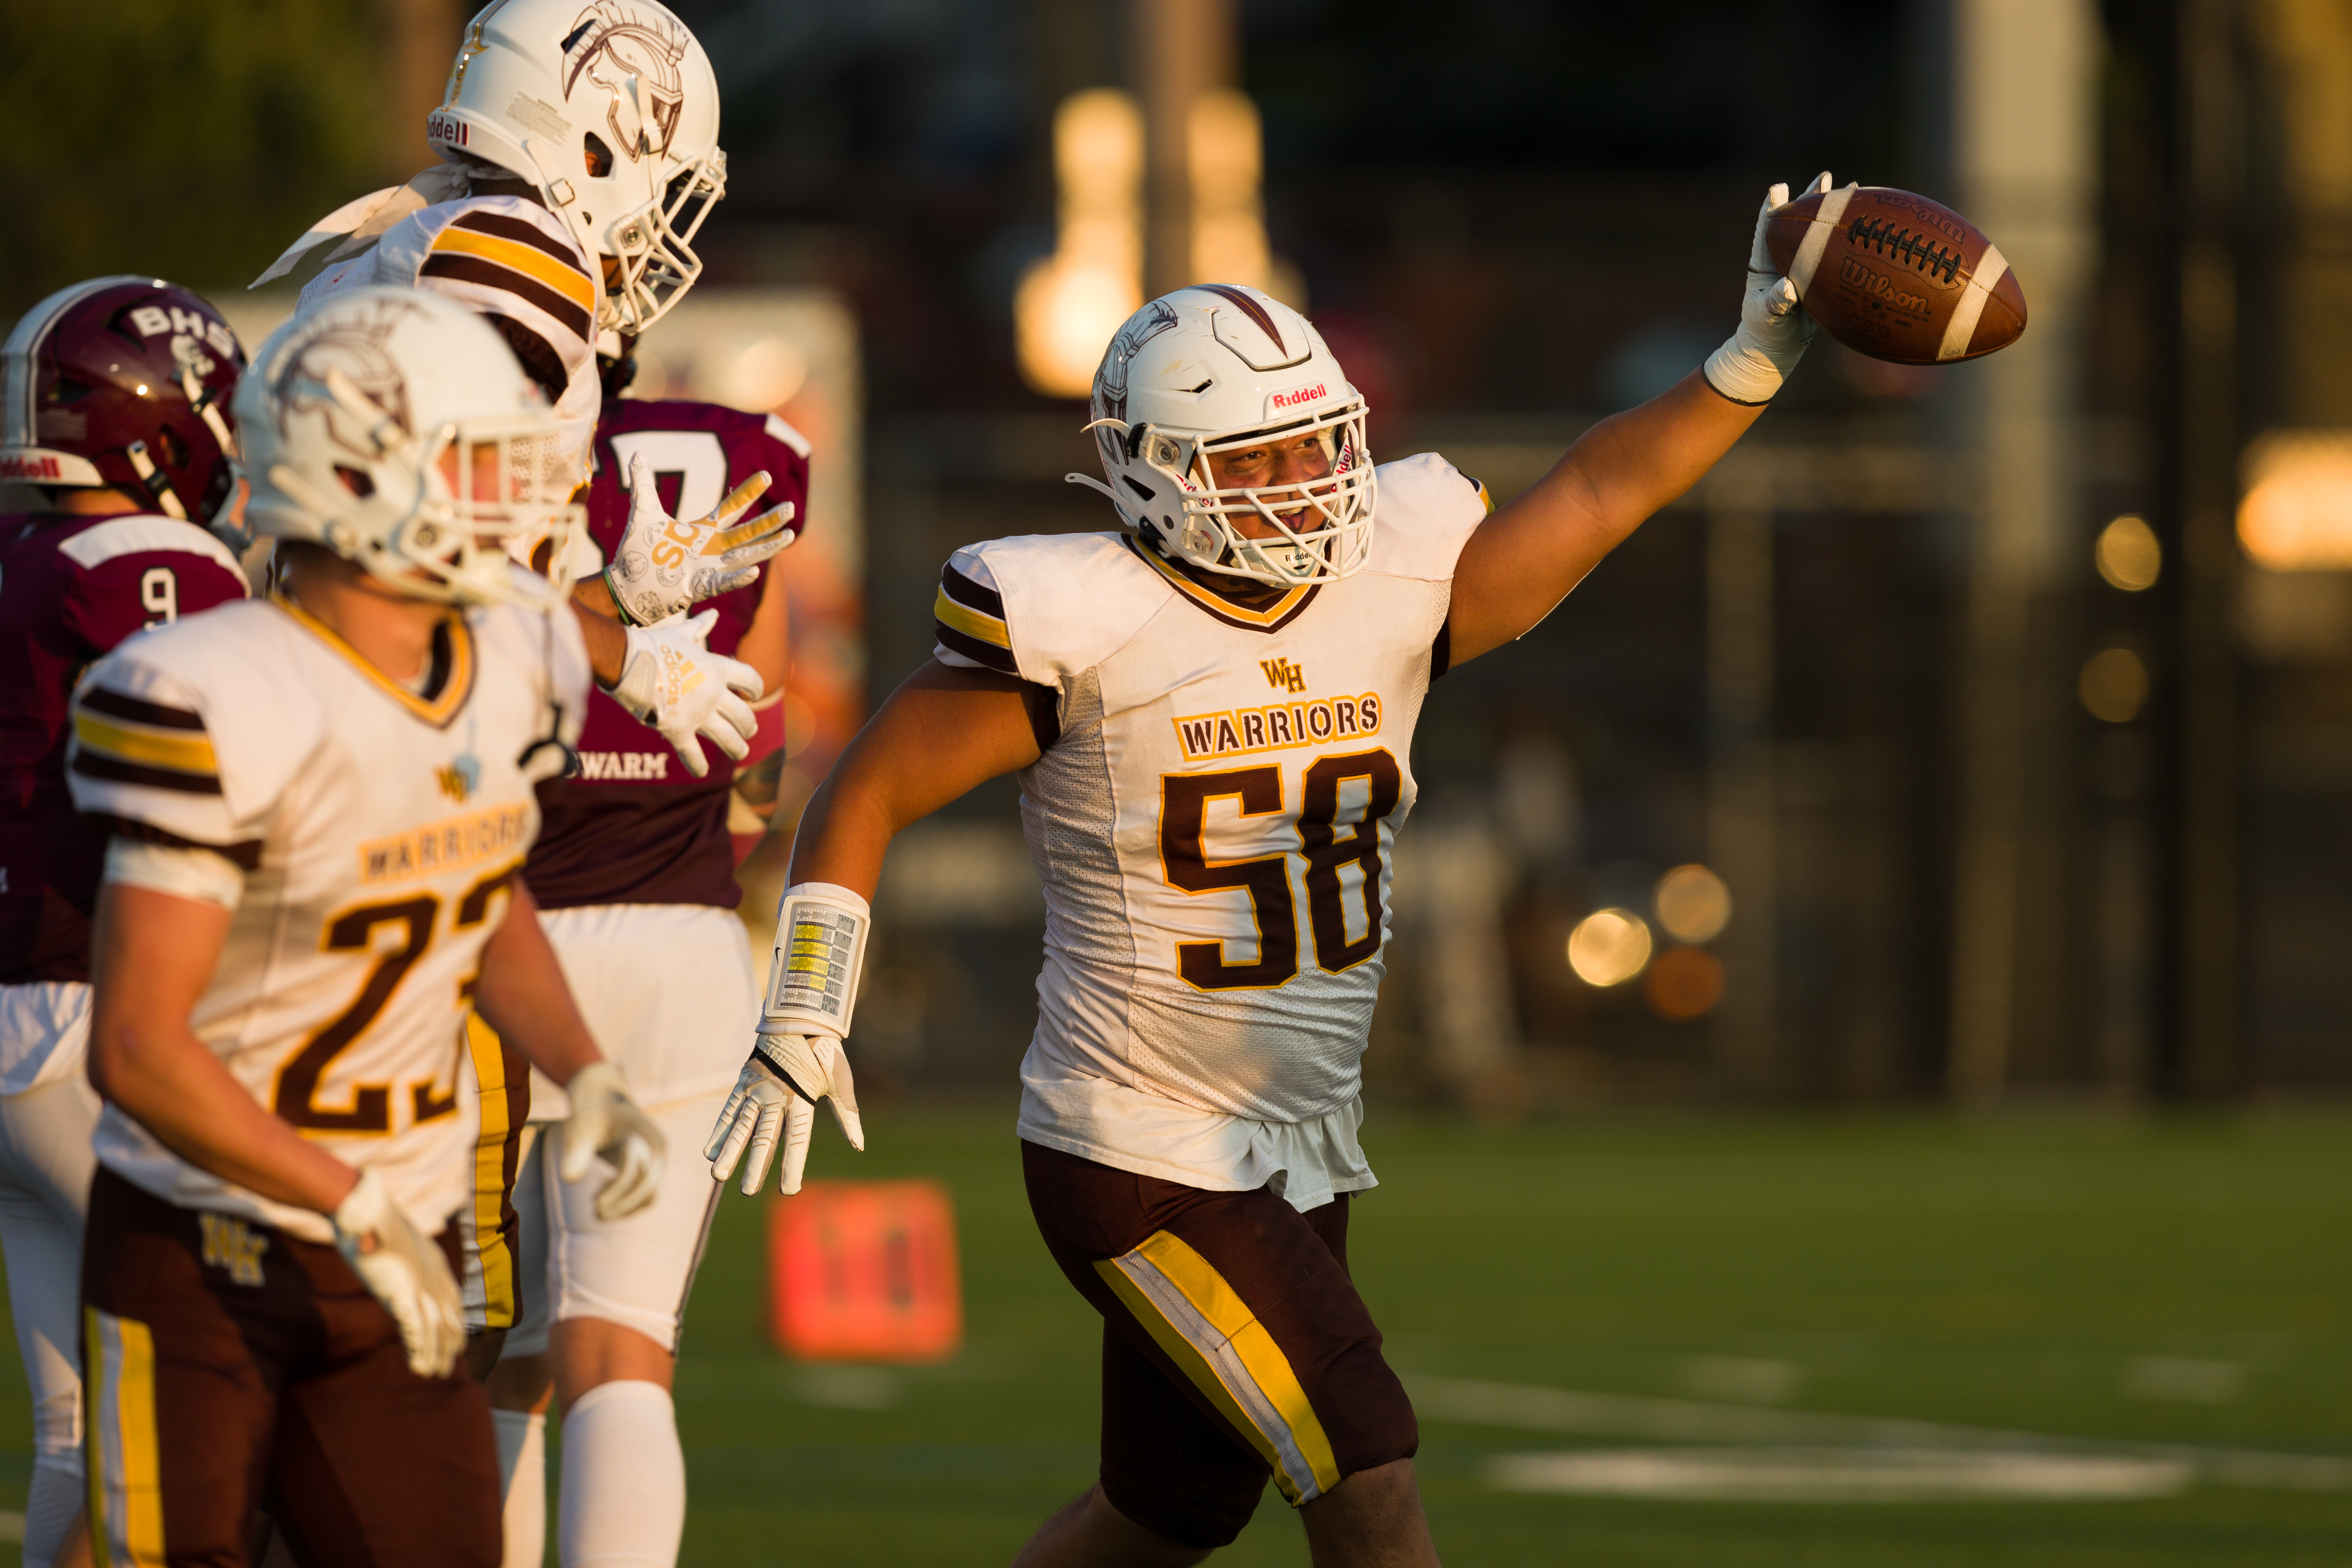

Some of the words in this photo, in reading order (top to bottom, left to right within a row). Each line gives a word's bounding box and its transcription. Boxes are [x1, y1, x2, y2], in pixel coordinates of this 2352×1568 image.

[427, 116, 468, 146] ddell
[1840, 257, 1928, 314] Wilson
[1272, 383, 1326, 409] Riddell
[140, 566, 178, 632] 9
[661, 645, 680, 706] adidas
[1260, 657, 1307, 693] WH
[1177, 695, 1380, 758] WARRIORS
[1158, 746, 1402, 993] 58
